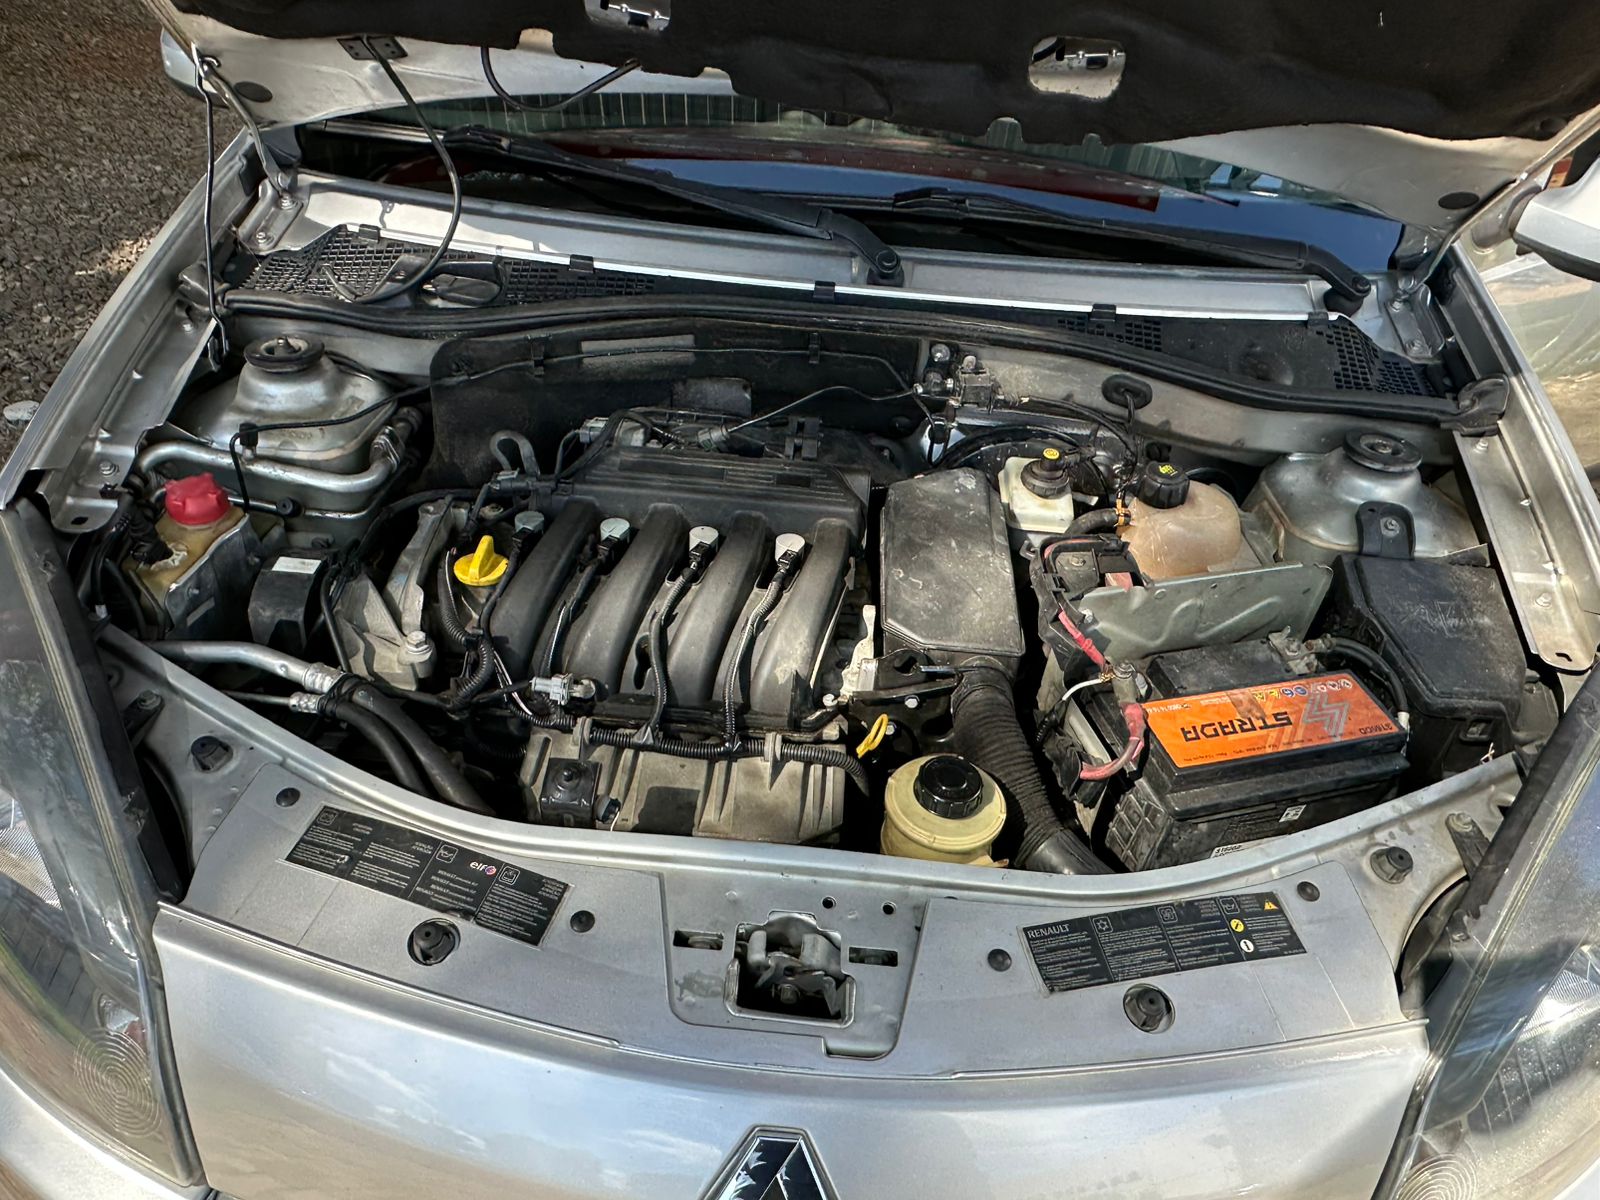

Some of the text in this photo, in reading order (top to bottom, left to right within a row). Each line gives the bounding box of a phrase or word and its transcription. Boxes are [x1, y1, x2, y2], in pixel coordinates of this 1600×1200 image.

[1180, 711, 1293, 743] STRADA
[469, 861, 487, 871] elf
[1026, 923, 1069, 938] RENAULT
